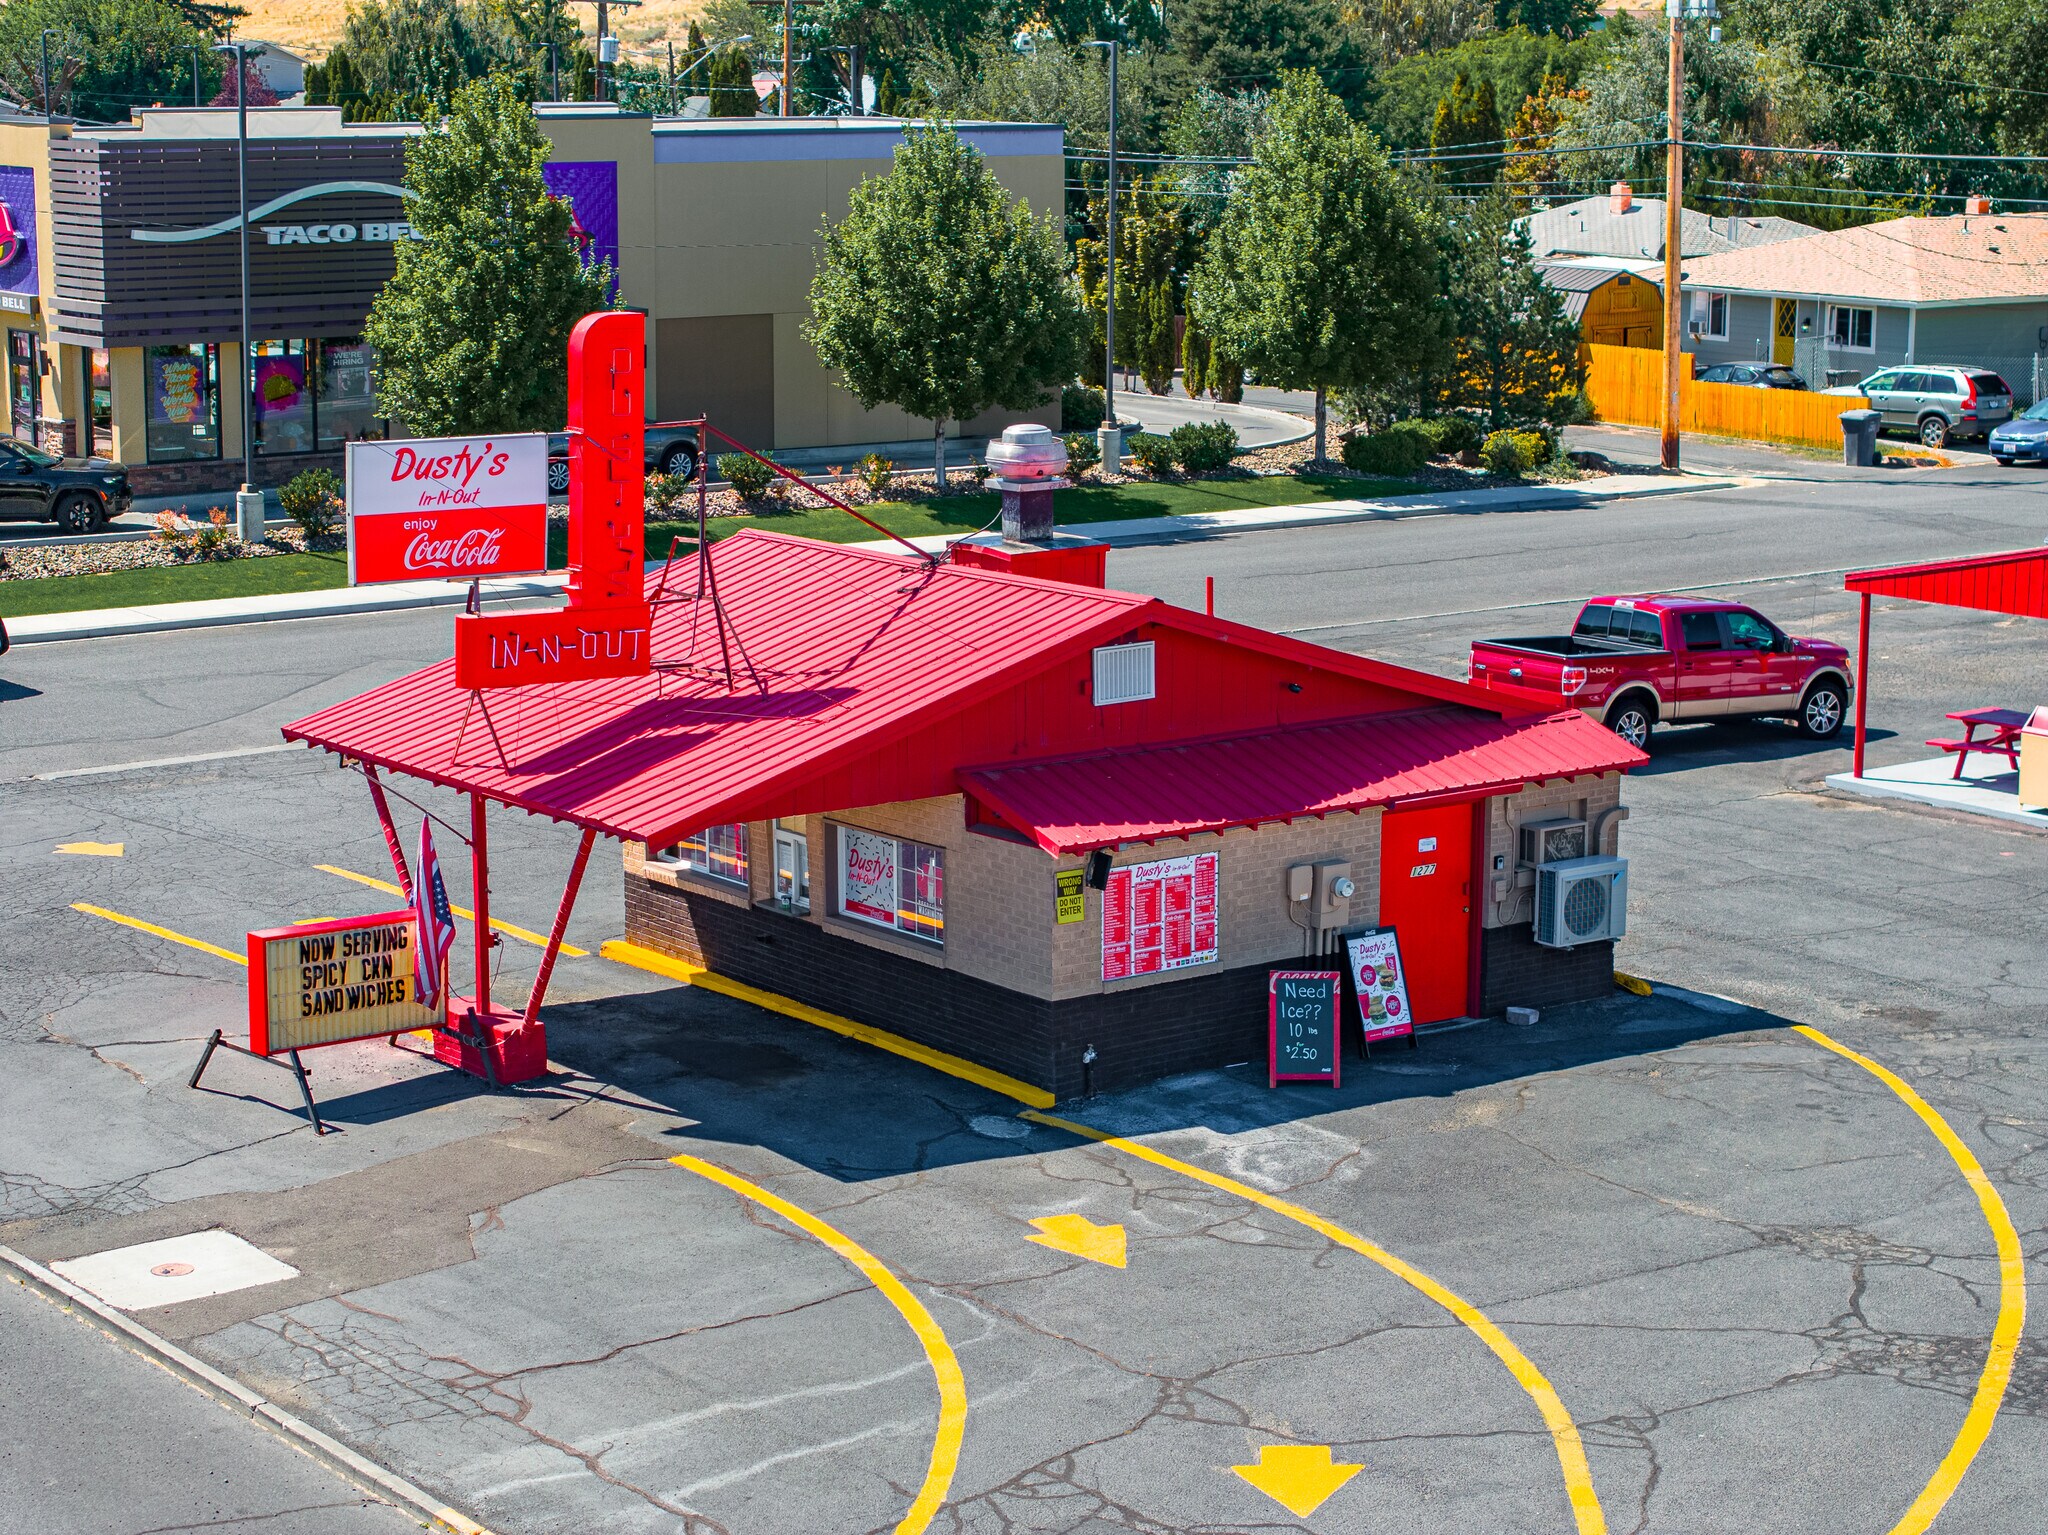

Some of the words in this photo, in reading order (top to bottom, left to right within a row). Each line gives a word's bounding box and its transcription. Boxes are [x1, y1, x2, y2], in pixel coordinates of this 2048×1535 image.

[260, 224, 357, 245] TACO
[362, 222, 424, 241] BEL
[2, 296, 25, 310] BELL
[333, 351, 362, 359] WE'RE
[333, 358, 364, 366] HIRING
[162, 362, 196, 374] When
[391, 442, 510, 487] Dusty's
[418, 487, 481, 506] In-N-Out
[403, 518, 438, 531] enjoy
[403, 527, 507, 571] Coca-Cola
[486, 628, 646, 669] IN-N-OUT
[848, 848, 894, 880] Dusty's
[1135, 862, 1171, 878] Dusty's
[1412, 864, 1436, 876] 1277
[848, 870, 876, 886] In-N-Out
[1058, 876, 1082, 888] WRONG
[1063, 886, 1077, 896] WAY
[1060, 898, 1069, 907] DO
[1070, 896, 1081, 905] NOT
[1060, 905, 1081, 916] ENTER
[300, 935, 335, 964] NOW
[342, 926, 408, 957] SERVING
[1360, 941, 1386, 955] Dusty's
[302, 960, 347, 990] SPICY
[362, 954, 393, 981] CKN
[302, 979, 405, 1016] SANDWICHES
[1285, 982, 1326, 999] Need
[1281, 1001, 1322, 1020] Ice??
[1289, 1022, 1303, 1038] 10
[1285, 1045, 1318, 1060] $2.50
